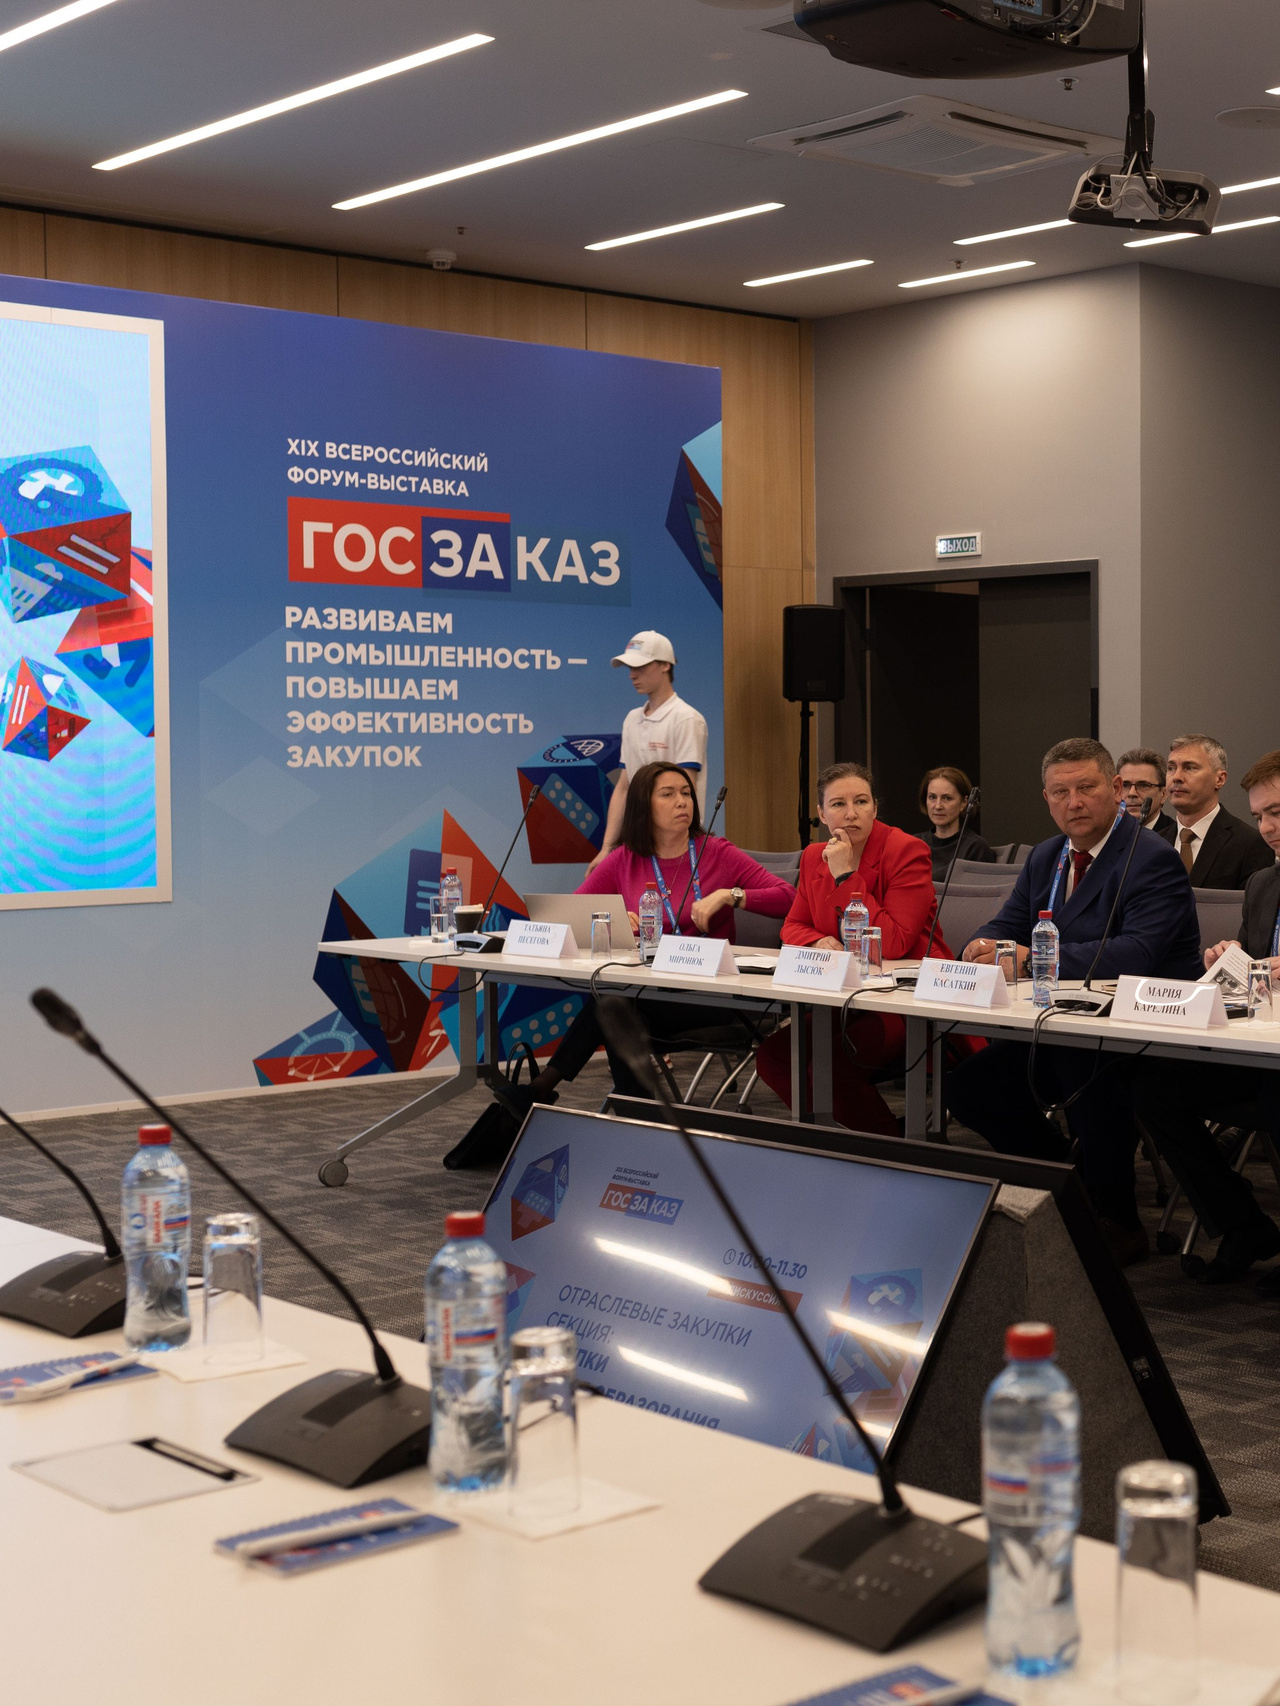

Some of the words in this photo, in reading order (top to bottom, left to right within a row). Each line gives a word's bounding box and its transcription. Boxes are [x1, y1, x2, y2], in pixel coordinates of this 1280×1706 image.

[287, 438, 319, 457] XIX
[325, 442, 489, 473] ВСЕРОССИЙСКИЙ
[287, 466, 469, 497] ФОРУМ-ВЫСТАВКА
[940, 537, 976, 554] ВЫХОД
[285, 606, 453, 634] РАЗВИВАЕМ
[285, 641, 561, 670] ПРОМЫШЛЕННОСТЬ
[286, 676, 458, 701] ПОВЫШАЕМ
[286, 711, 534, 735] ЭФФЕКТИВНОСТЬ
[286, 745, 422, 768] ЗАКУПОК
[679, 943, 701, 952] ОЛЬГА
[795, 950, 831, 962] ДМИТРИЙ
[669, 955, 704, 966] МИРОНЮК
[794, 965, 824, 975] ЛЫСЮК
[940, 963, 977, 976] ЕВГЕНИЙ
[933, 978, 976, 991] КАСАТКИН
[1146, 986, 1182, 999] МАРИЯ
[1133, 1001, 1186, 1016] КАРЕЛИНА
[559, 1284, 668, 1326] ОТРАСЛЕВЫЕ
[668, 1311, 752, 1347] ЗАКУПКИ
[546, 1311, 614, 1344] СЕКЦИЯ:
